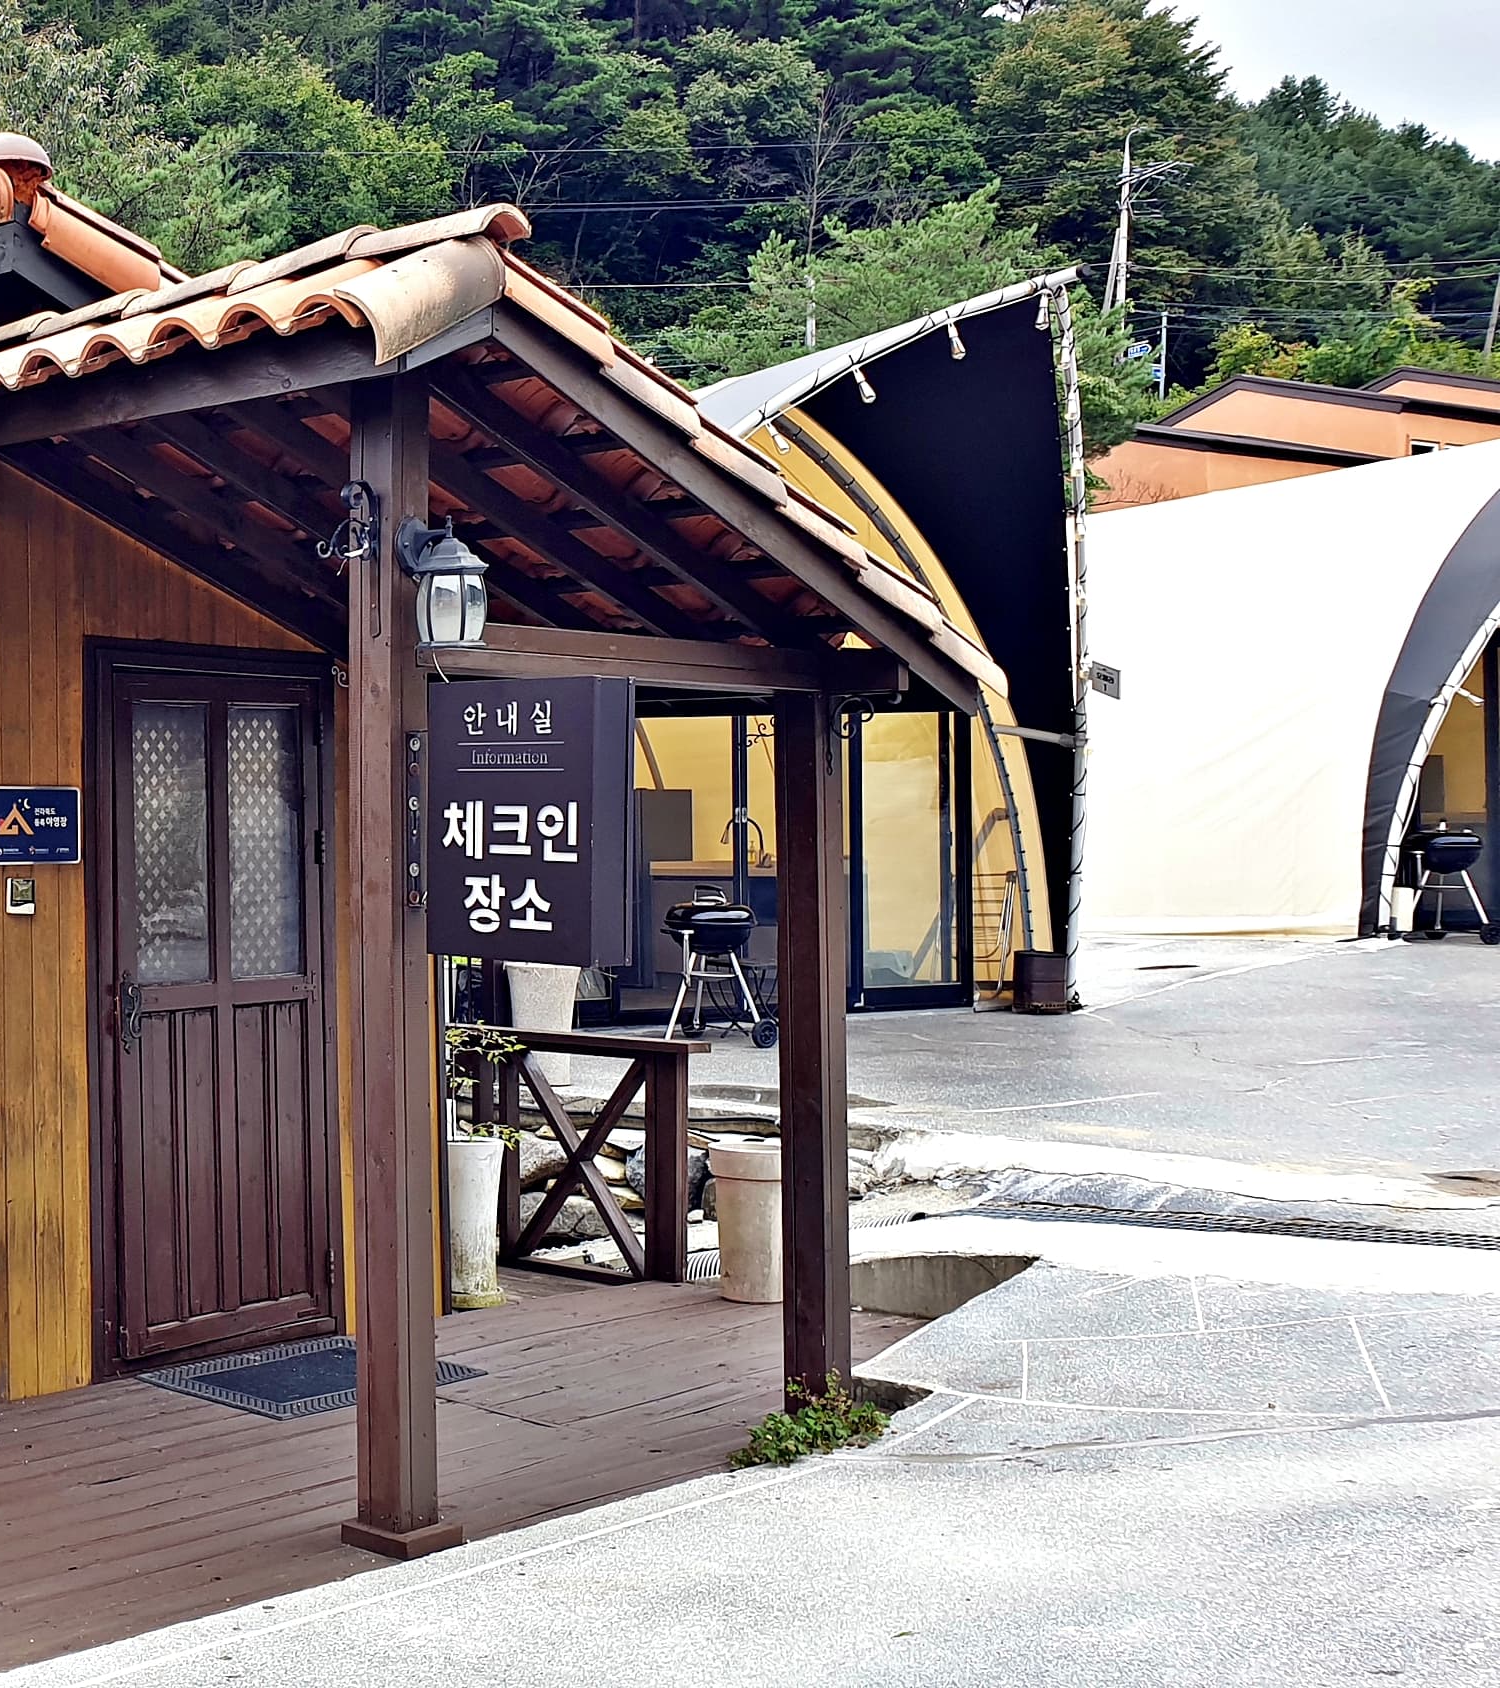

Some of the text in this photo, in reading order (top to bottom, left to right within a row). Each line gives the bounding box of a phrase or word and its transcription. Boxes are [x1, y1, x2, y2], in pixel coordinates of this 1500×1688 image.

[462, 700, 553, 736] 안내실
[471, 748, 549, 765] Information
[441, 800, 579, 863] 체크인
[463, 874, 553, 933] 장소
